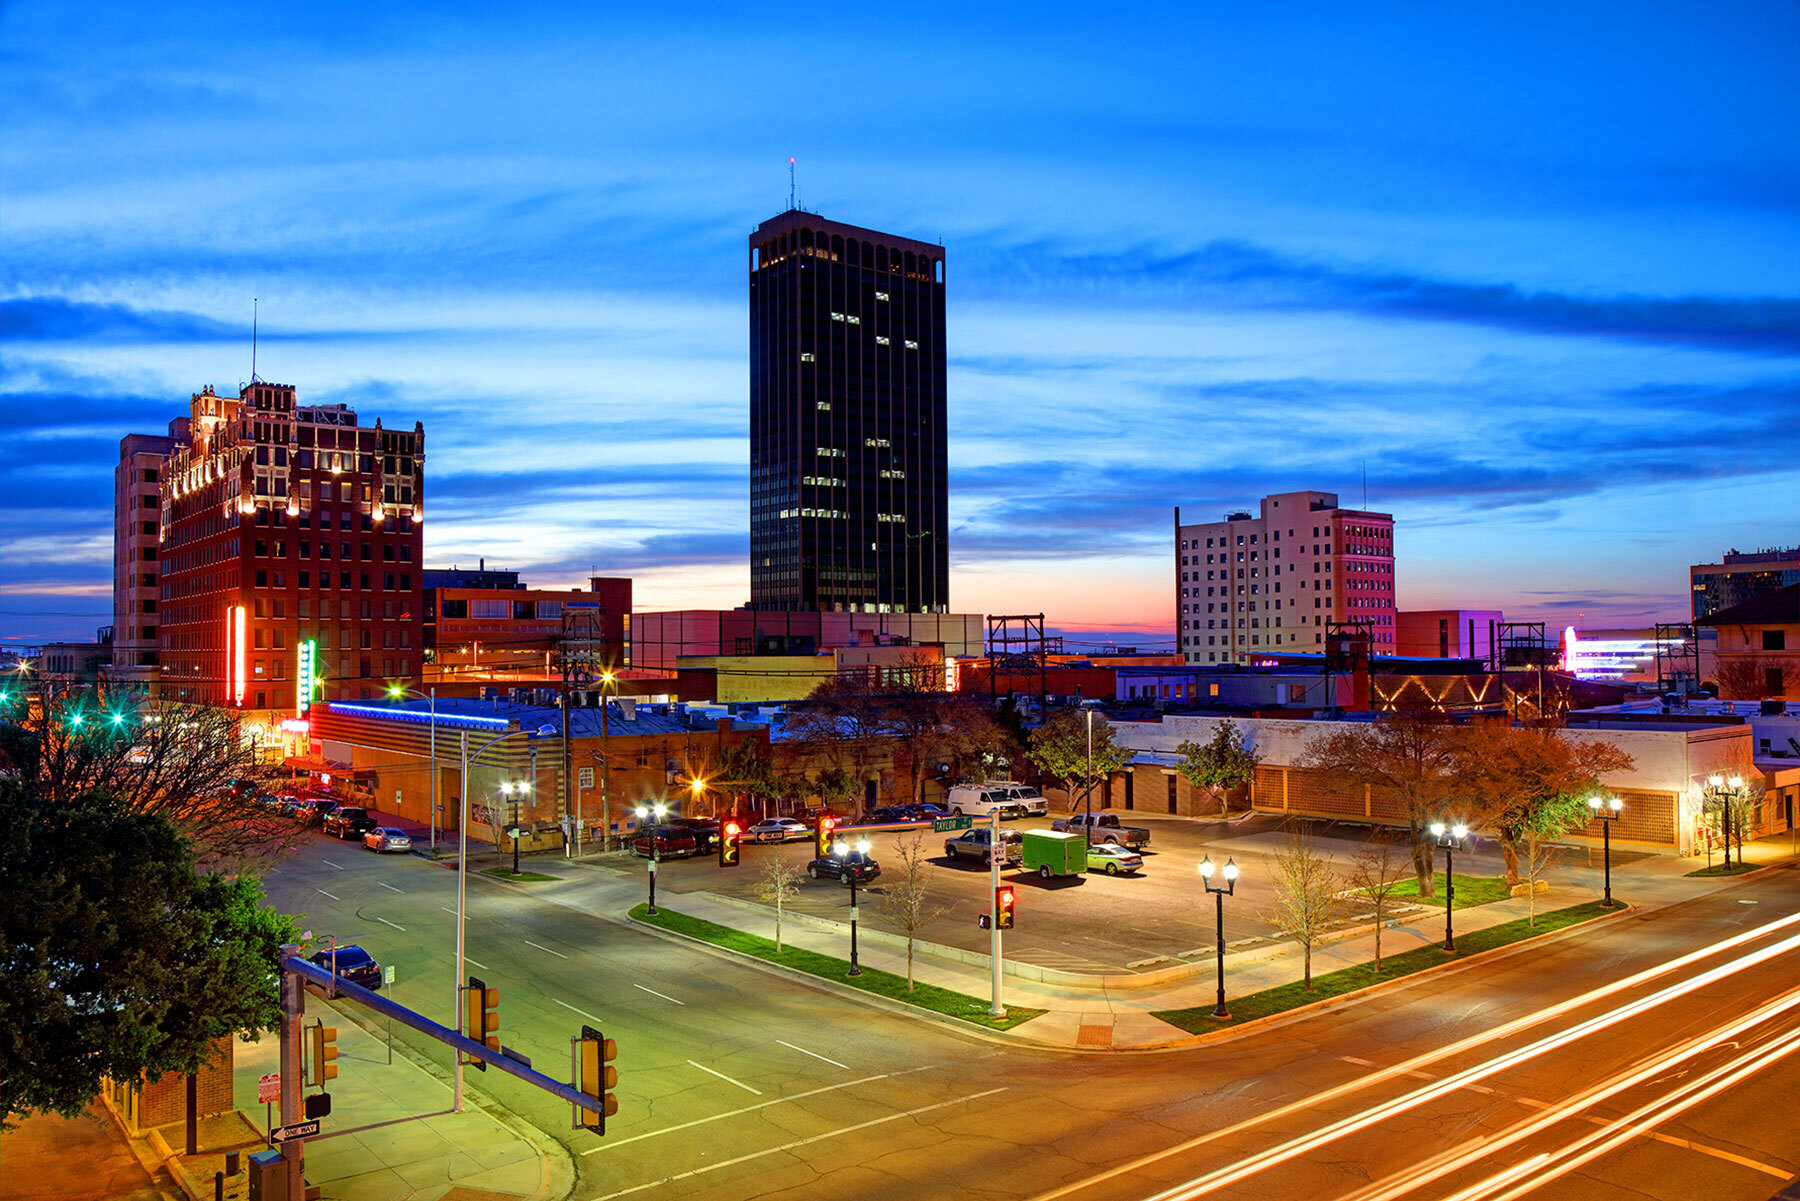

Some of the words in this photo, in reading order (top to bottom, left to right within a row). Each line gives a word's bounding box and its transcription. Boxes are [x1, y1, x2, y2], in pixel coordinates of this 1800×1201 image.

[936, 820, 957, 831] TAYLOR
[285, 1129, 298, 1137] ONE
[301, 1125, 315, 1133] WAY
